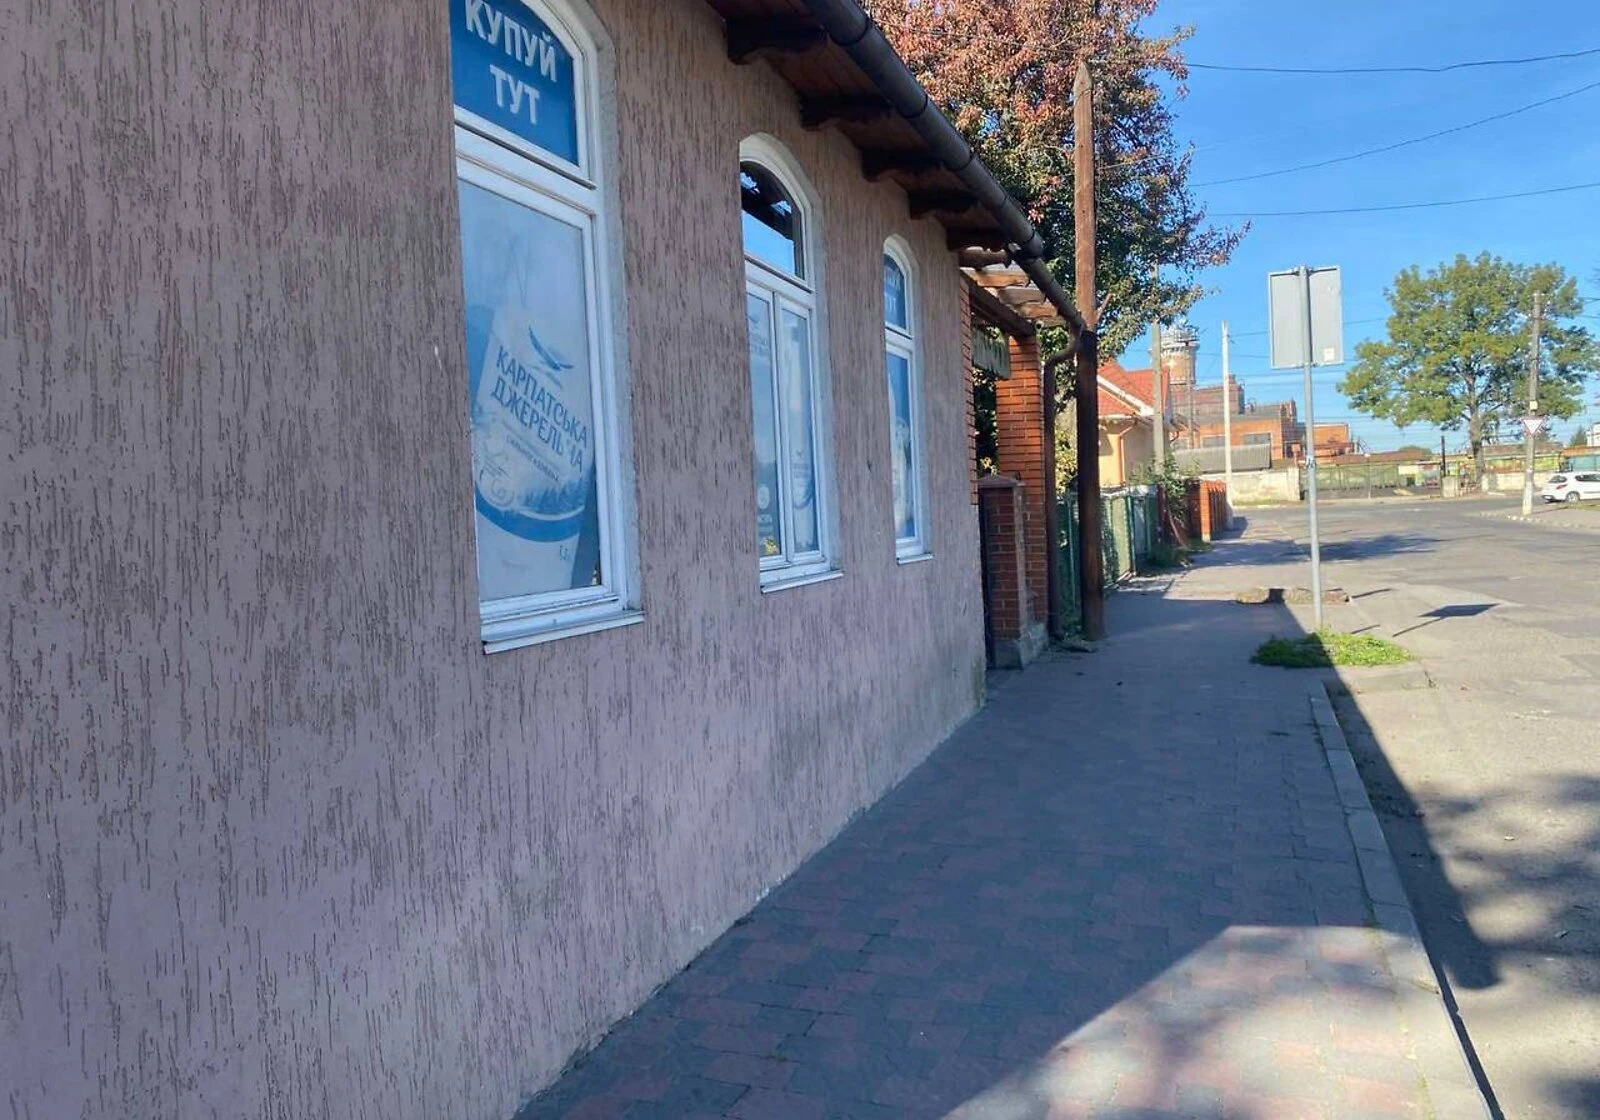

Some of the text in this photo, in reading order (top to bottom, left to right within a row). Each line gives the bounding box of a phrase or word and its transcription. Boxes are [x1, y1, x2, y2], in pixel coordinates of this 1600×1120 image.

[464, 0, 557, 82] КУПУЙ
[489, 64, 540, 125] ТУТ
[496, 345, 587, 449] КАРПАТСЬКА
